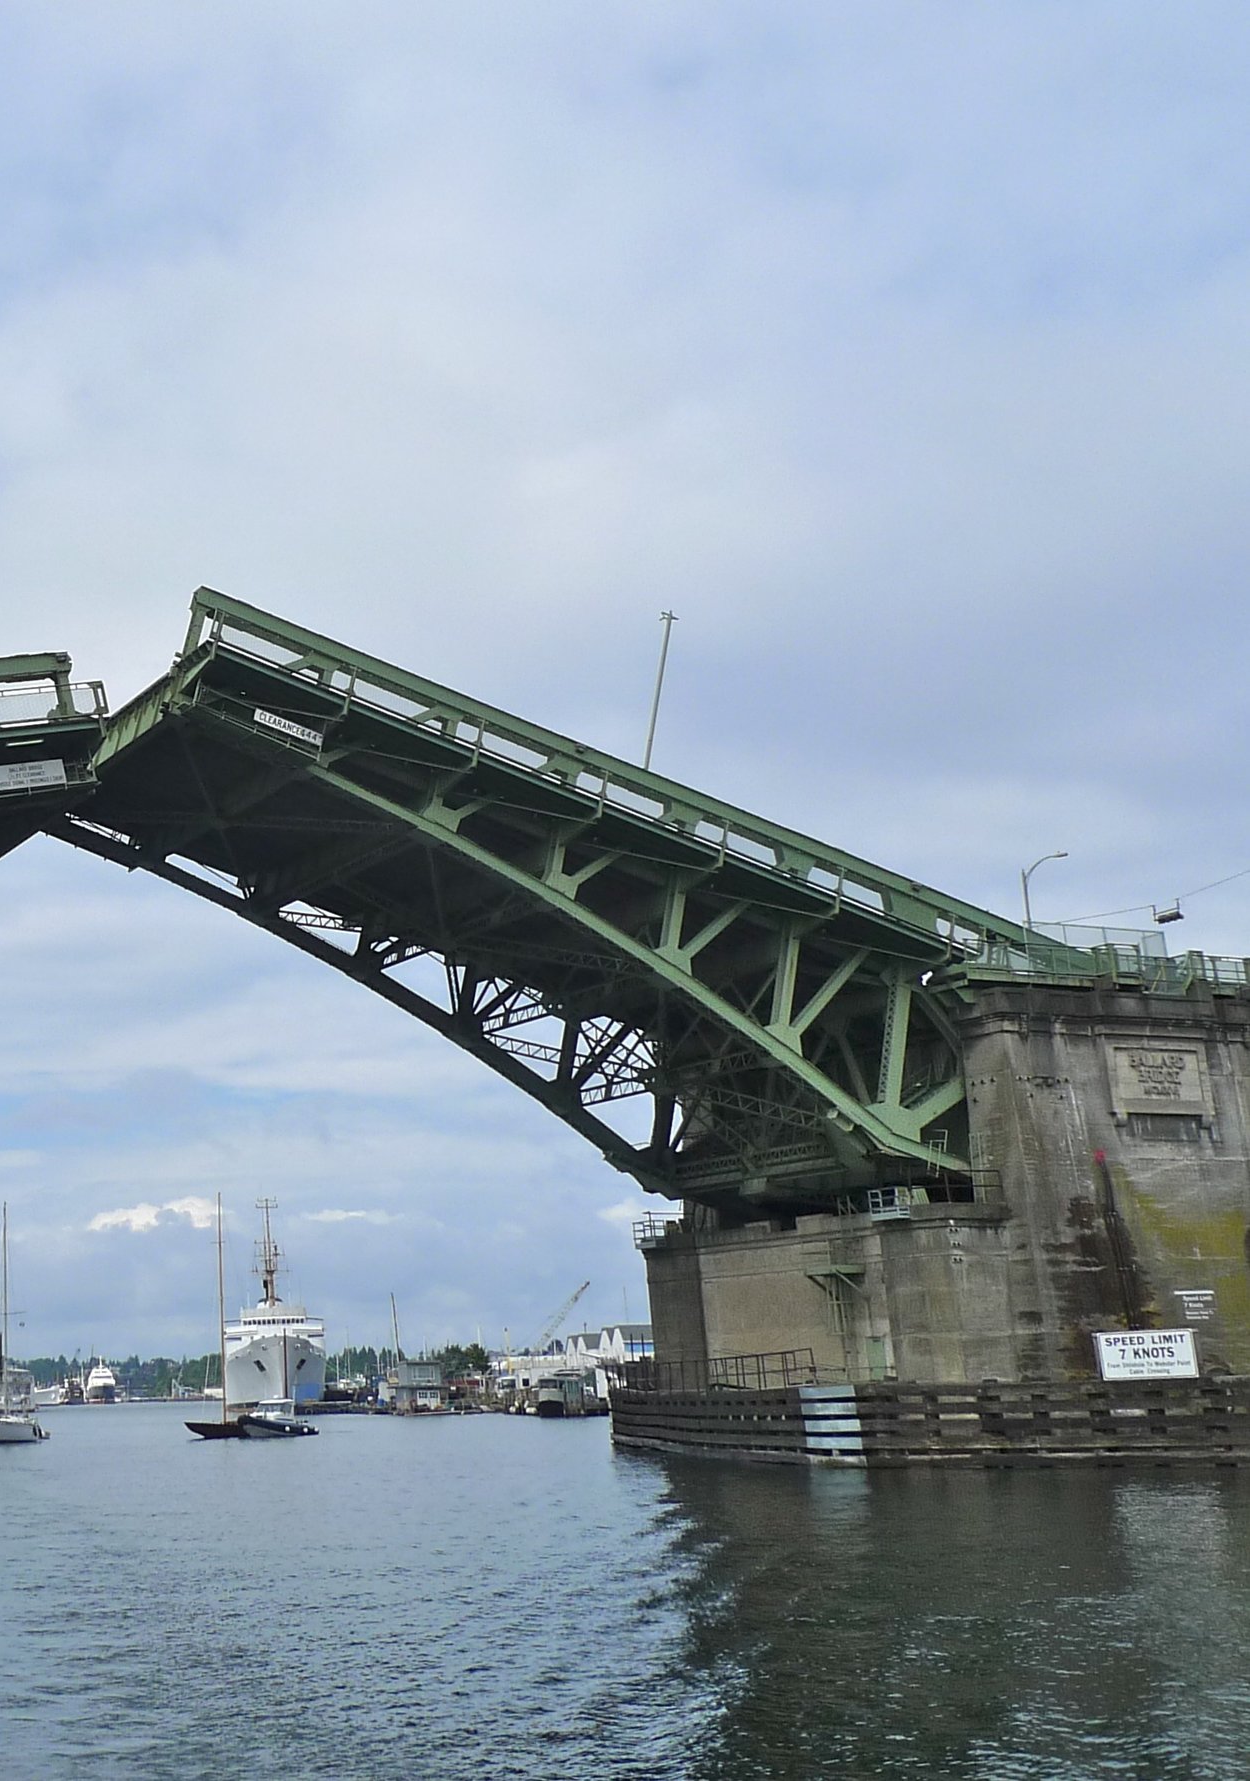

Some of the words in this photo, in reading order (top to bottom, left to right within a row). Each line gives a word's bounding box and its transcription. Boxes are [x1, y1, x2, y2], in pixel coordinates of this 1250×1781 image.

[259, 712, 301, 735] CLEARANCE
[1129, 1053, 1185, 1070] BALLARD
[1105, 1335, 1145, 1347] SPEED
[1151, 1334, 1185, 1345] LIMIT
[1119, 1349, 1126, 1360] 7
[1133, 1346, 1175, 1360] KNOTS
